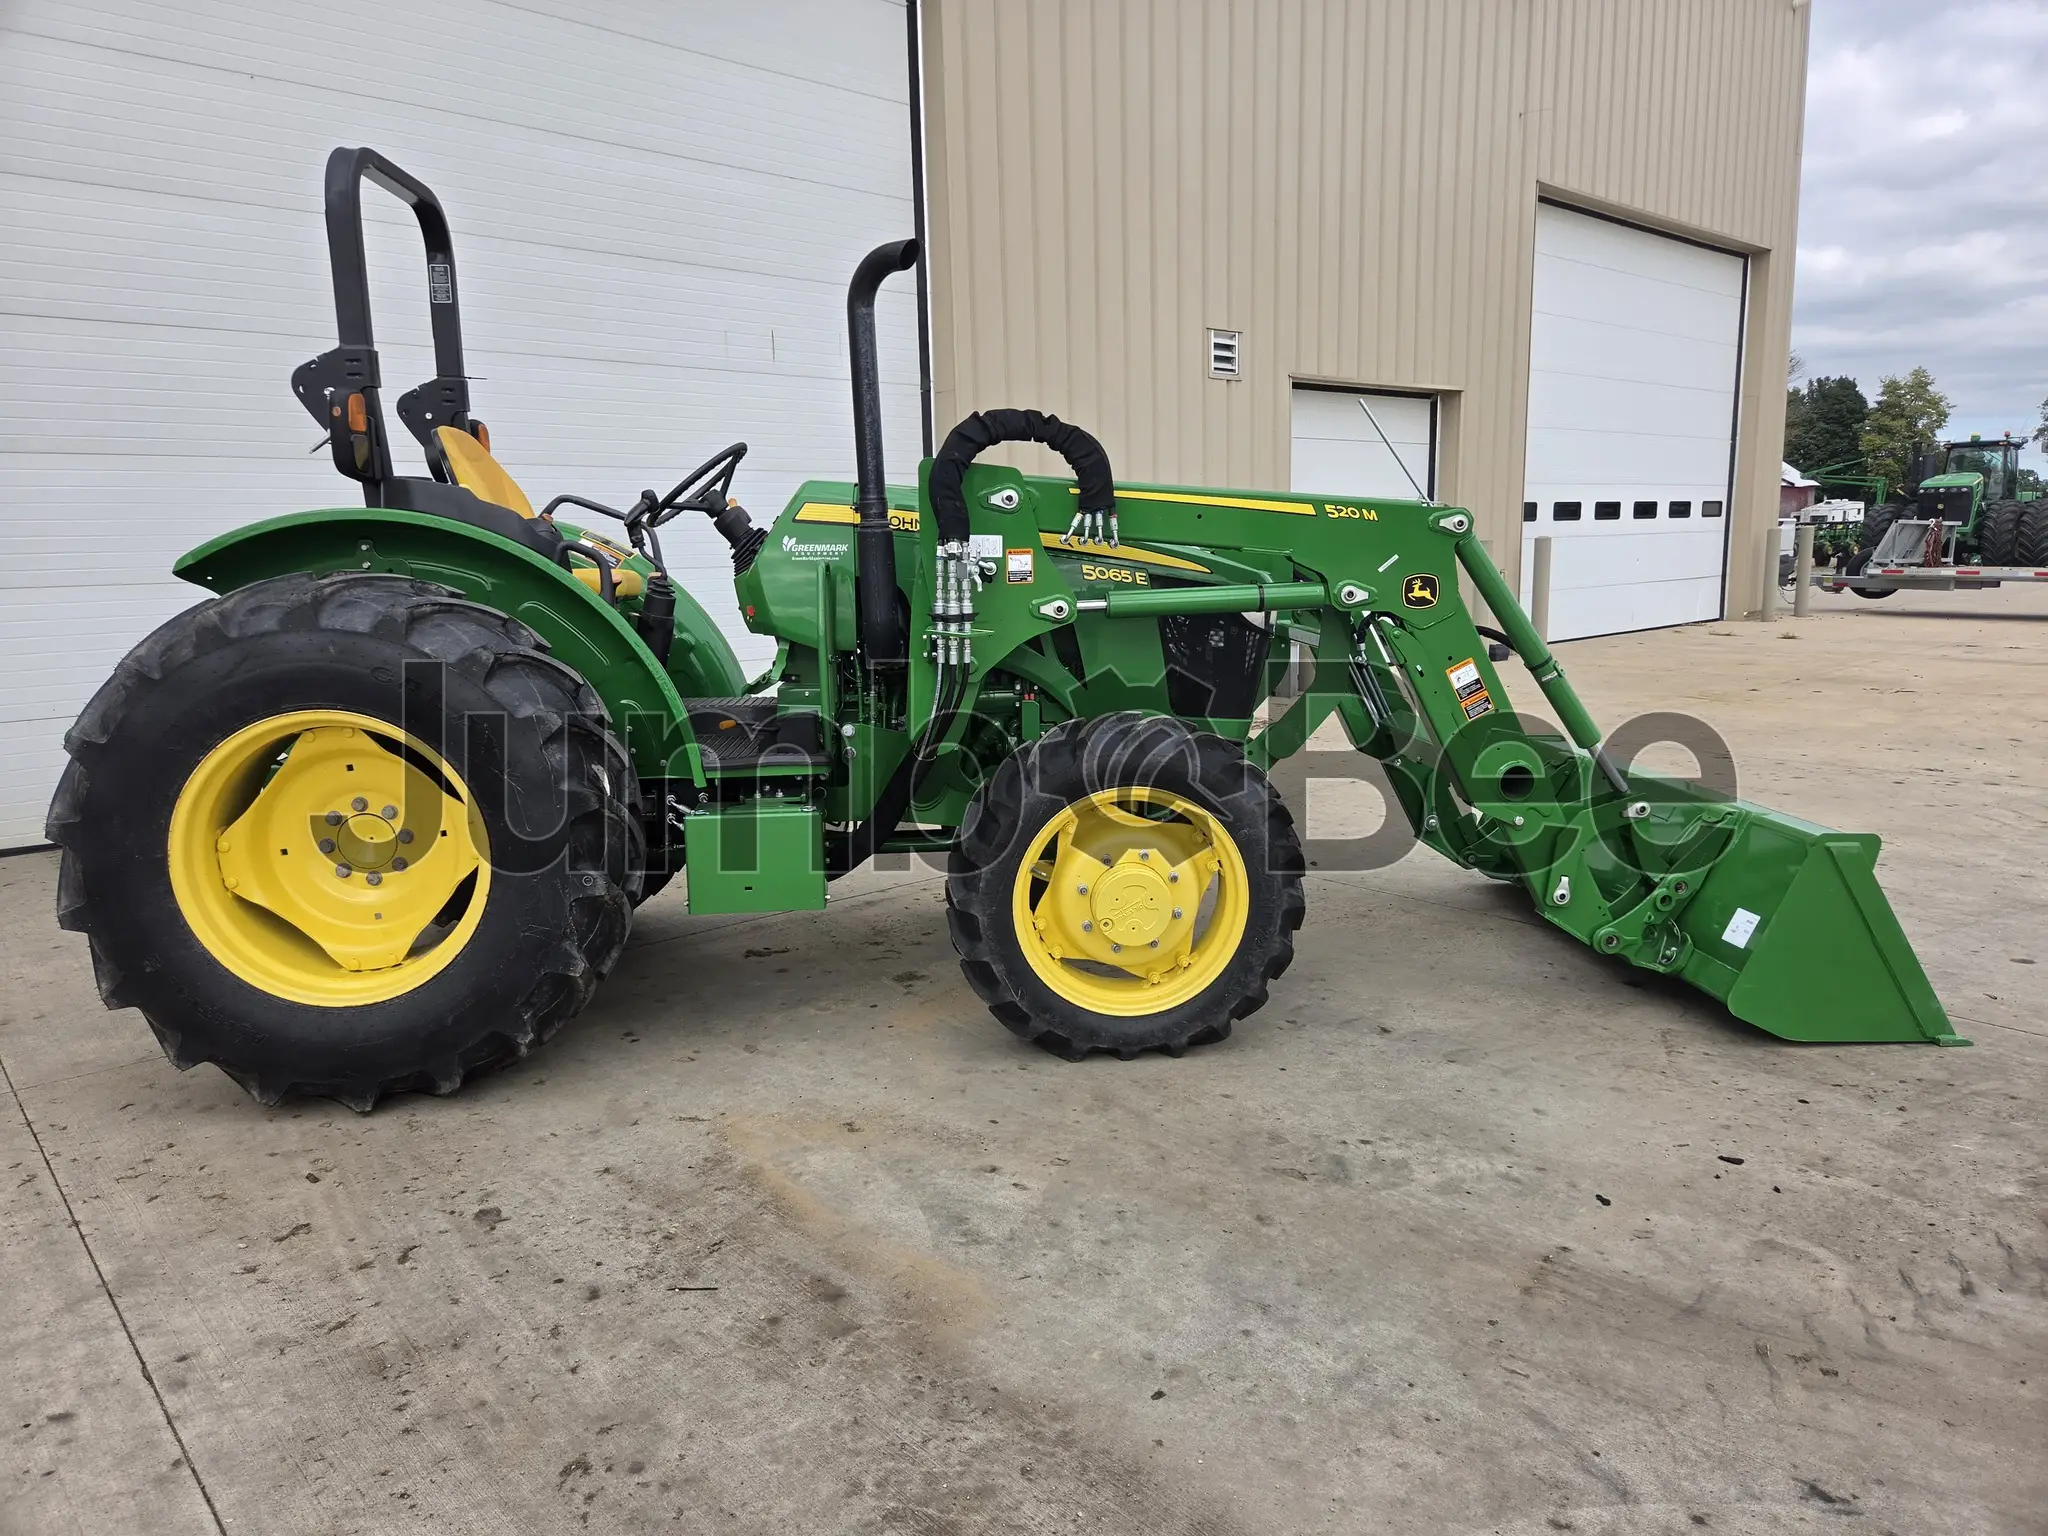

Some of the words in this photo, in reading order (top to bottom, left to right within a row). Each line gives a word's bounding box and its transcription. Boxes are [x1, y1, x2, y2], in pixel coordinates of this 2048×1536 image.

[1324, 504, 1360, 519] 520
[1361, 507, 1379, 522] M
[889, 516, 920, 529] OH
[791, 543, 849, 551] GREENMARK
[1081, 563, 1133, 582] 5065
[1134, 571, 1148, 586] E
